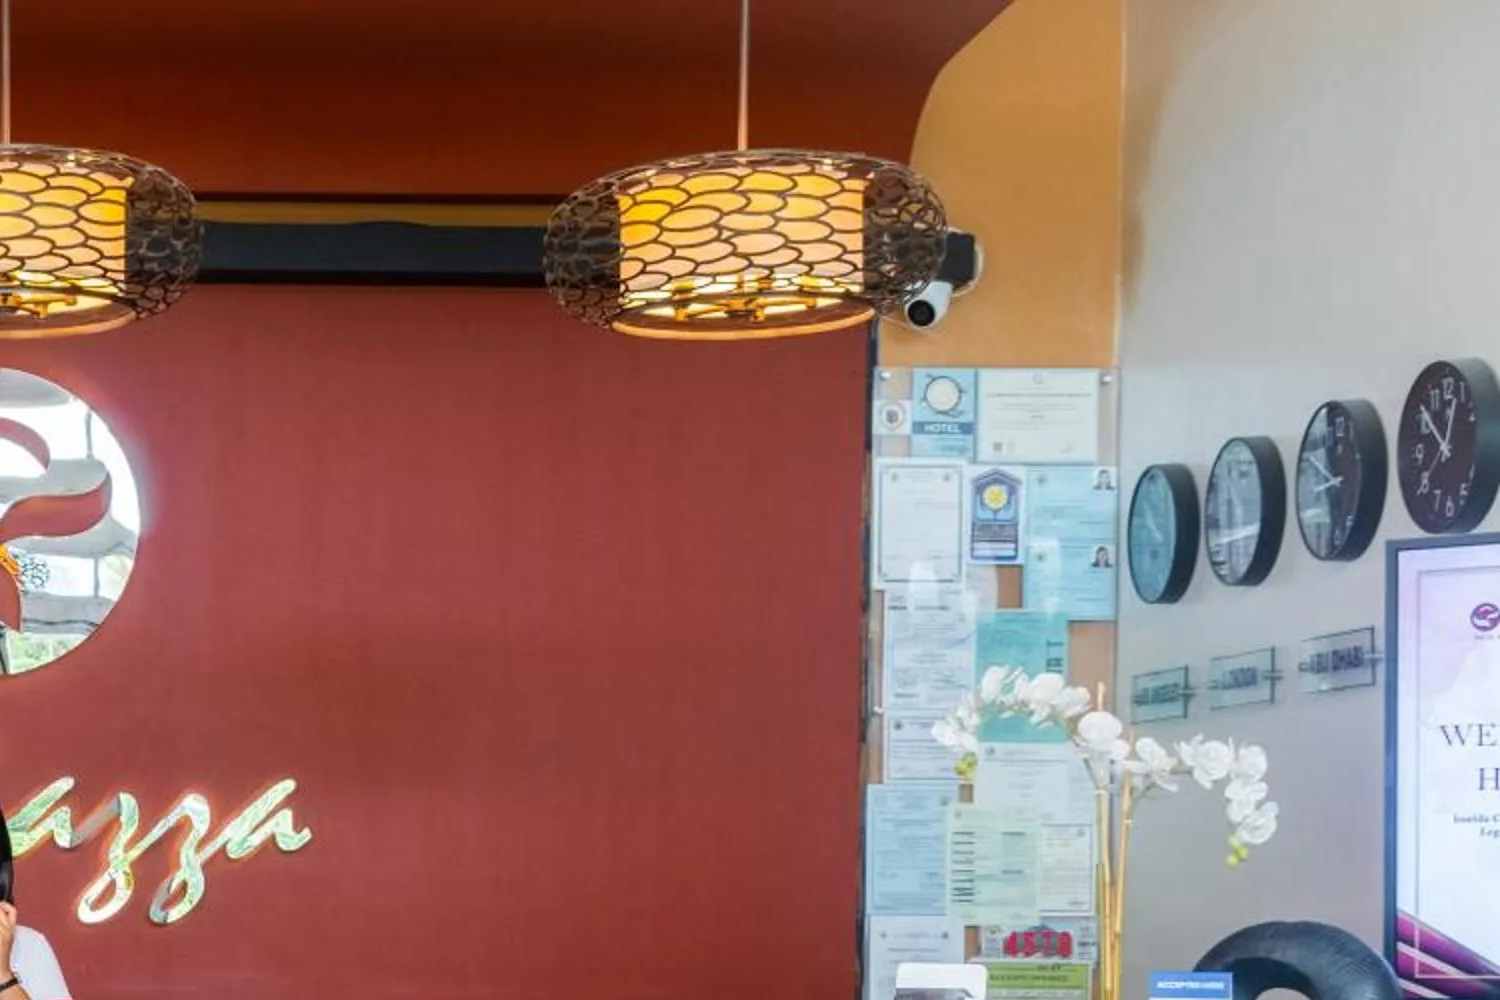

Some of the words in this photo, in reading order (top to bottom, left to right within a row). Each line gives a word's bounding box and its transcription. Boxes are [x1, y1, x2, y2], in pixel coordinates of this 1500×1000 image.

[1442, 377, 1454, 400] 12
[924, 423, 962, 433] HOTEL
[1414, 443, 1425, 465] 9
[1433, 489, 1442, 513] 7
[1445, 496, 1455, 517] 6
